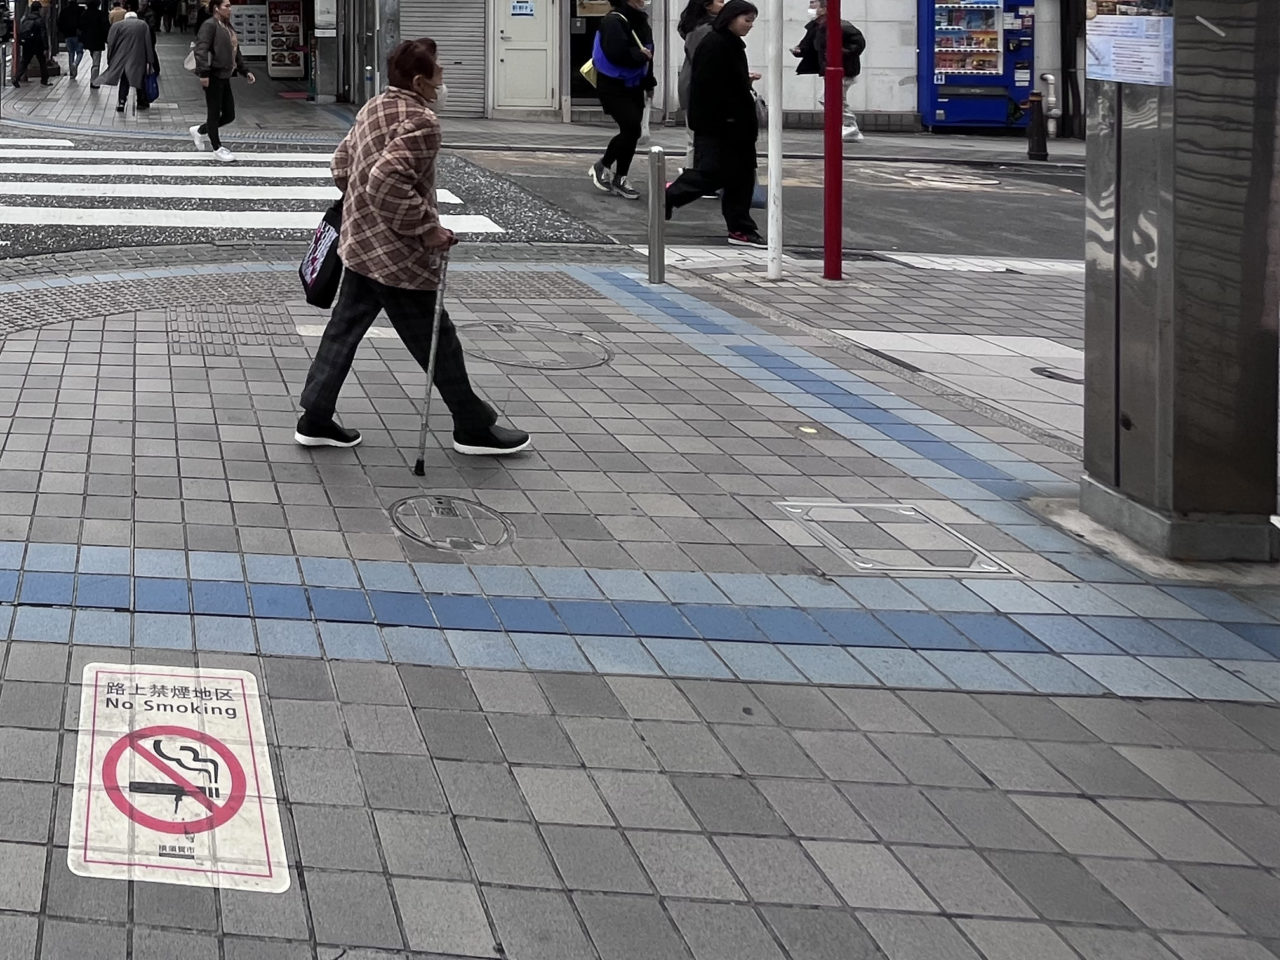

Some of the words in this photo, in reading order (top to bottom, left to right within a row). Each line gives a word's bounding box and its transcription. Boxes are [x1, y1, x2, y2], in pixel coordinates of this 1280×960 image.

[106, 681, 236, 702] 路上禁煙地区
[106, 697, 133, 710] No
[144, 699, 237, 719] Smoking
